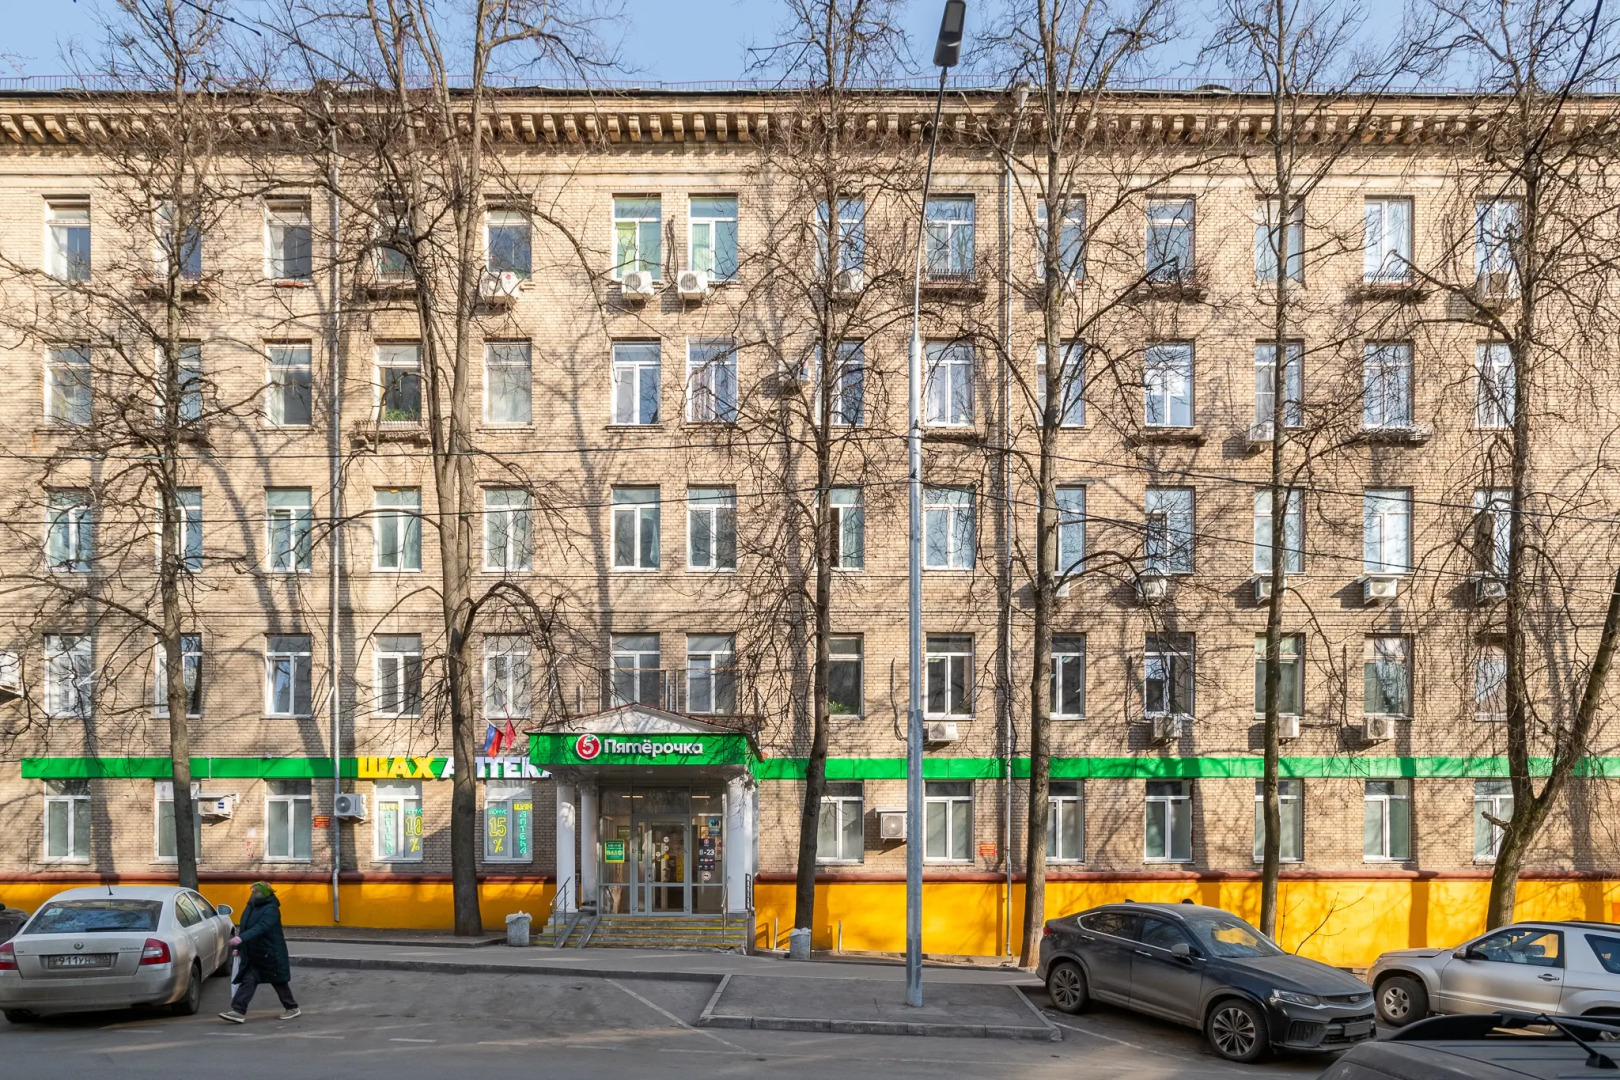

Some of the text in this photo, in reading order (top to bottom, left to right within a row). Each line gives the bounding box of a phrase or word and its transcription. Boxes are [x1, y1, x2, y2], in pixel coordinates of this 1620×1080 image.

[604, 739, 703, 757] Пятёрочка
[357, 755, 436, 778] ШАХ
[405, 816, 424, 836] 10
[488, 817, 507, 837] 15
